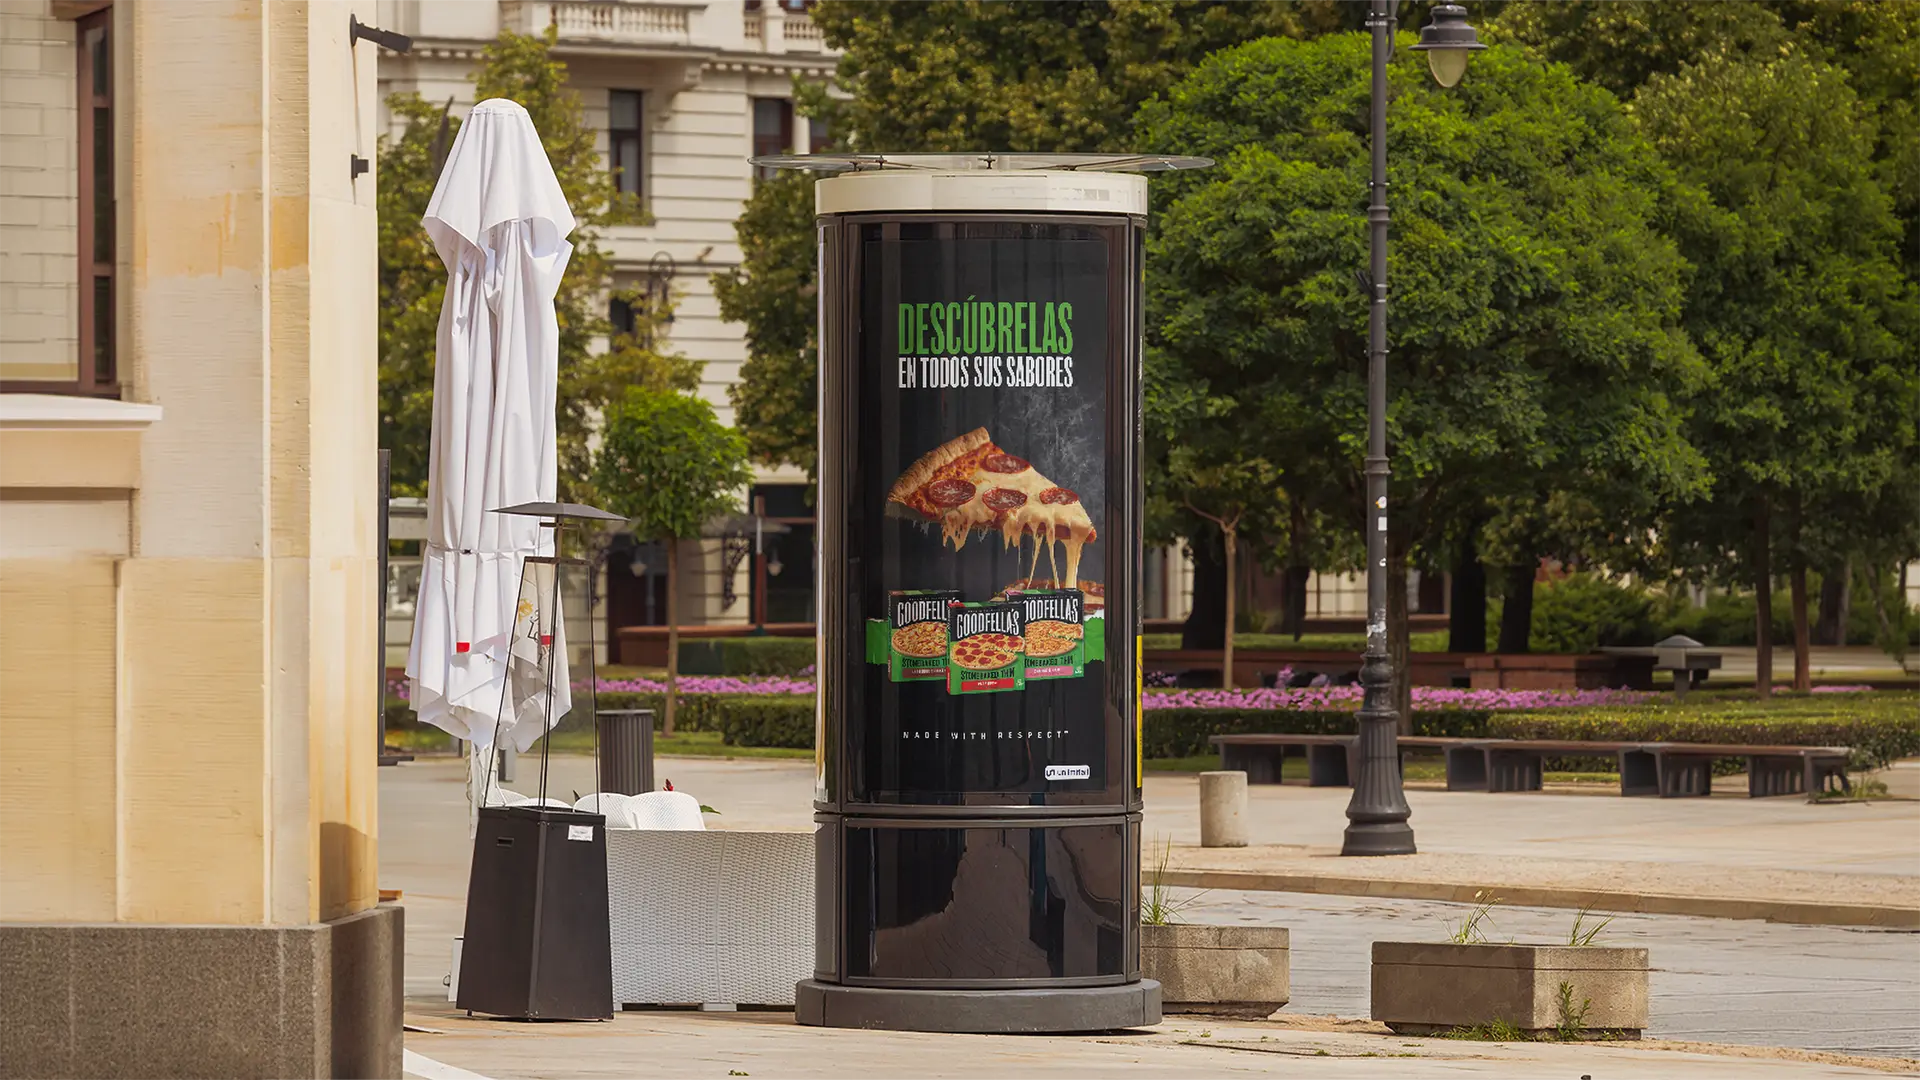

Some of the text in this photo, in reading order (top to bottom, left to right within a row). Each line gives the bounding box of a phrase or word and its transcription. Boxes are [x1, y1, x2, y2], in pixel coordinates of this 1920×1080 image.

[898, 294, 1074, 355] DESCÚBRELAS
[898, 356, 1074, 388] EN TODOS SUS SABORES
[956, 608, 1020, 639] GOODFELLA'S
[951, 732, 987, 740] WITH
